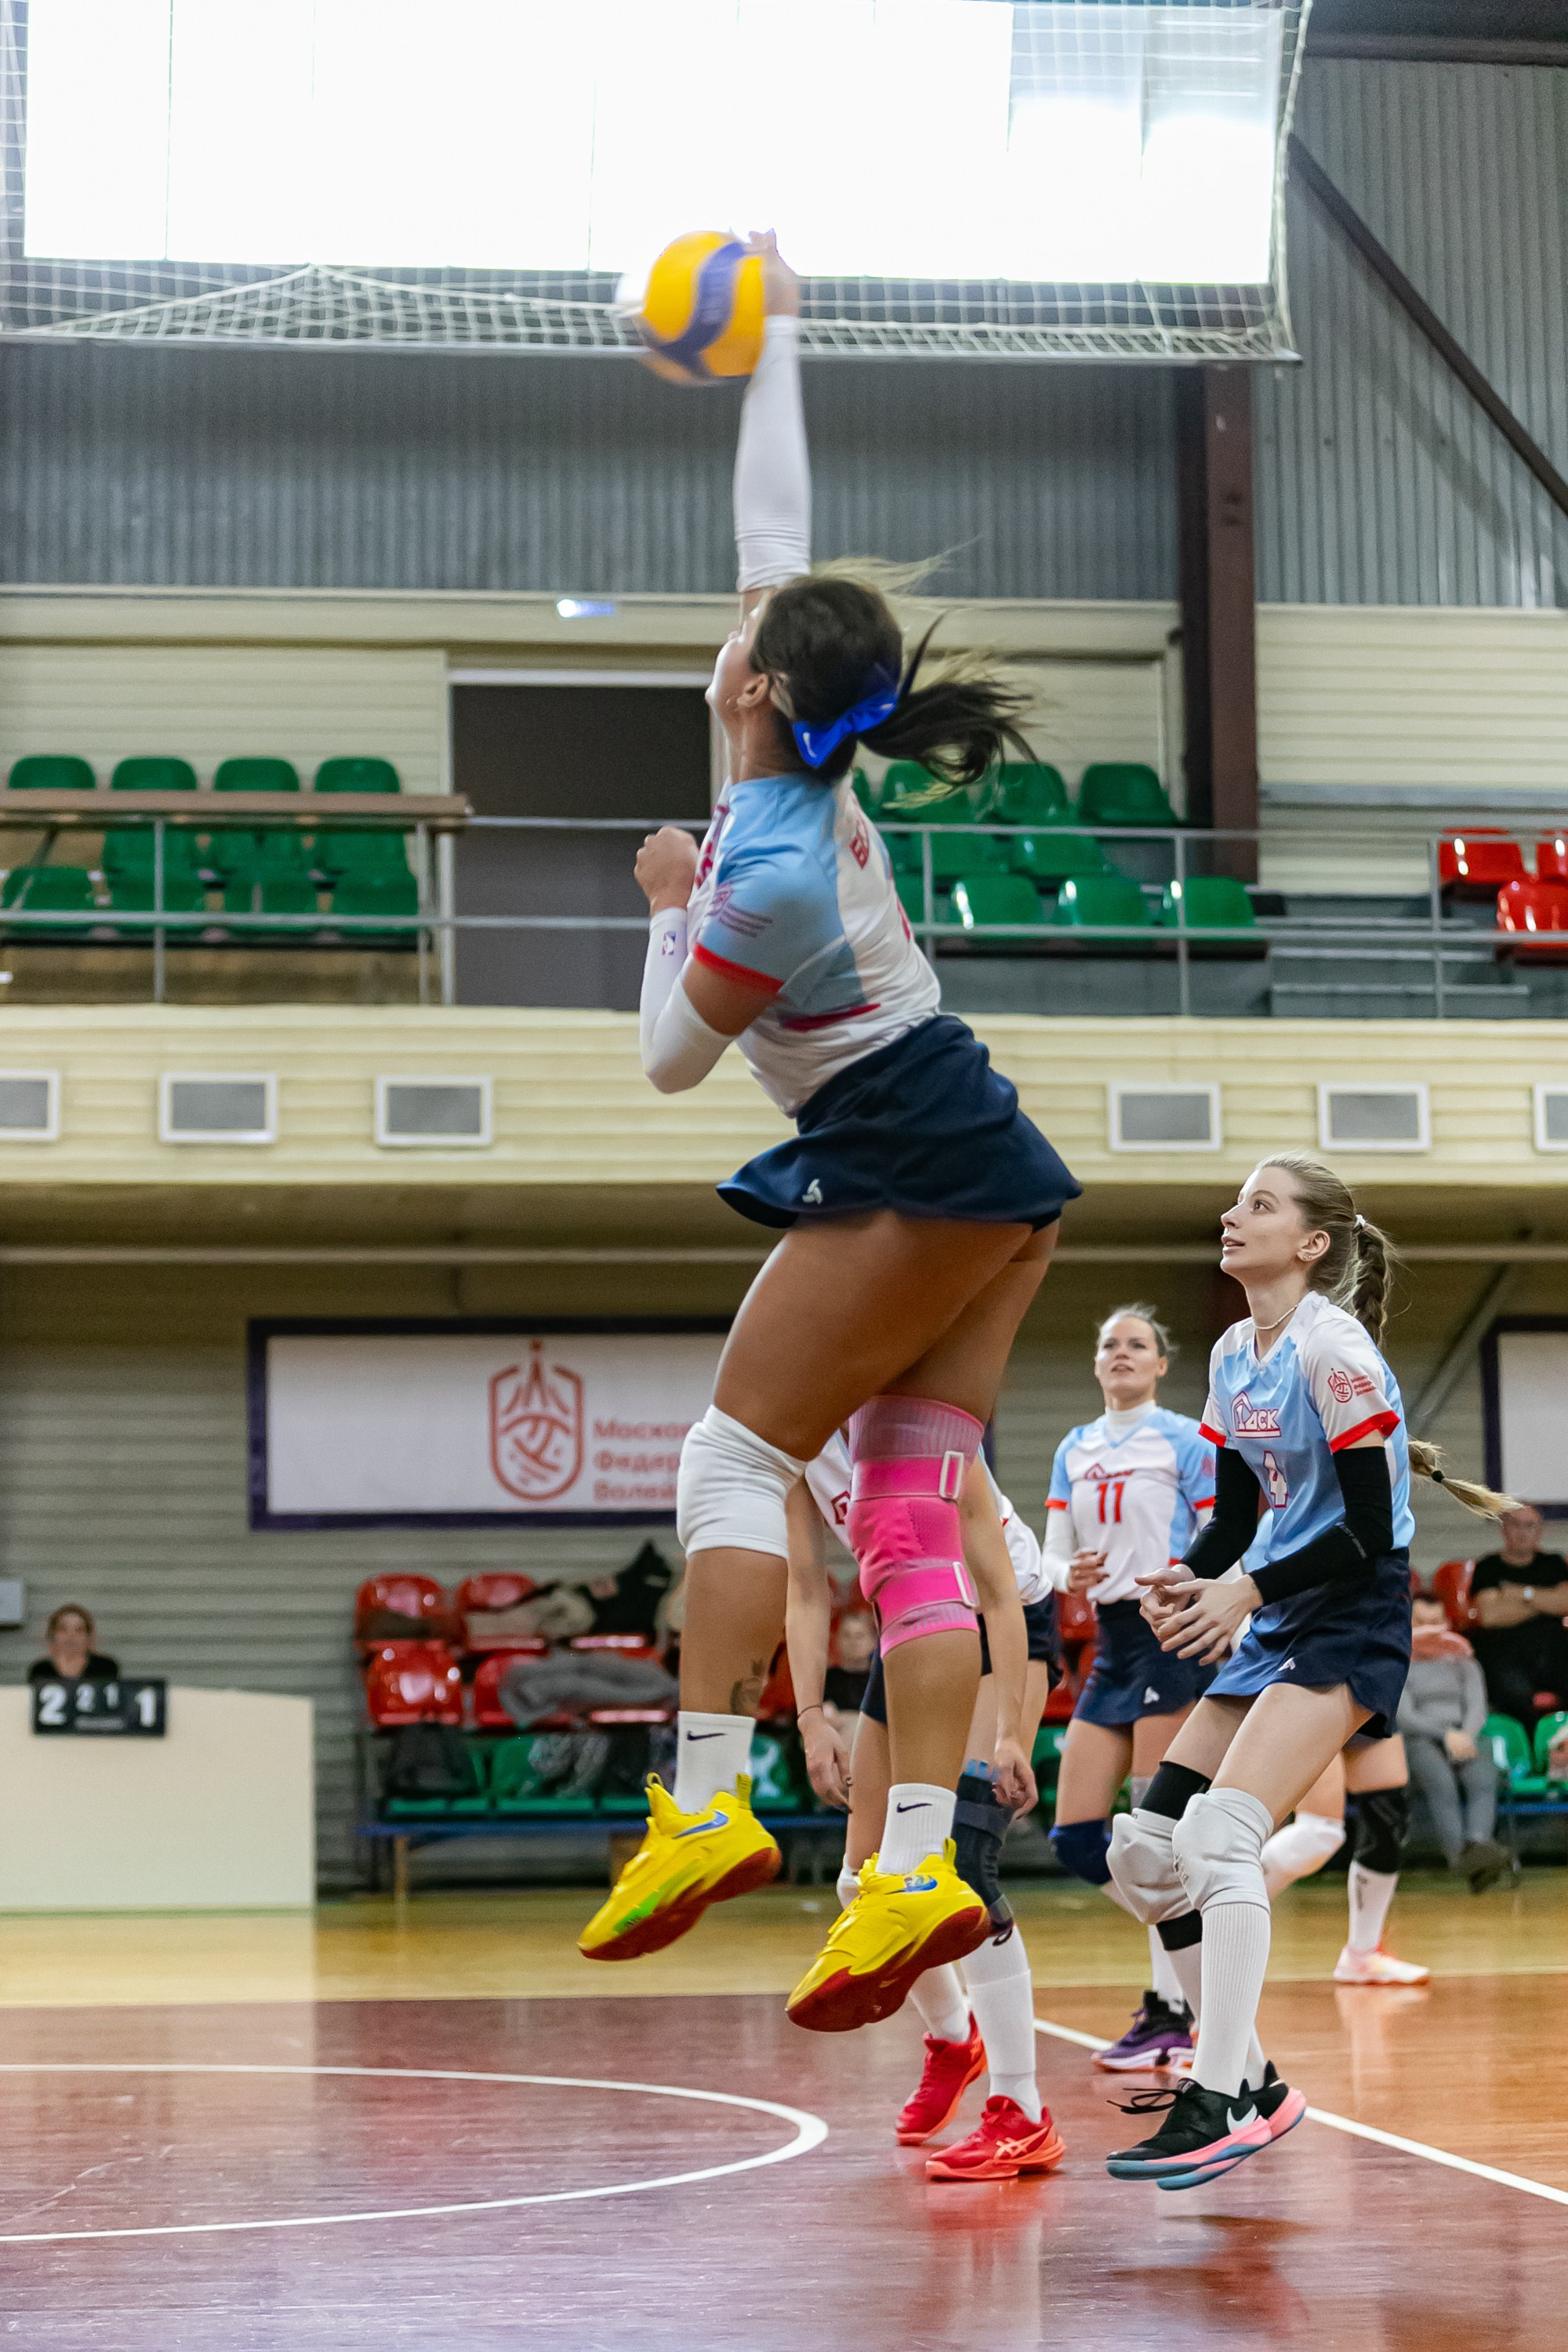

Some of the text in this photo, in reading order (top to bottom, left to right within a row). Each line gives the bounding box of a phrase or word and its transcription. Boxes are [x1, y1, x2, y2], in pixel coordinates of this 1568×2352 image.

[1263, 1450, 1290, 1508] 4
[1095, 1481, 1125, 1524] 11
[39, 1684, 67, 1725] 2
[134, 1686, 156, 1728] 1
